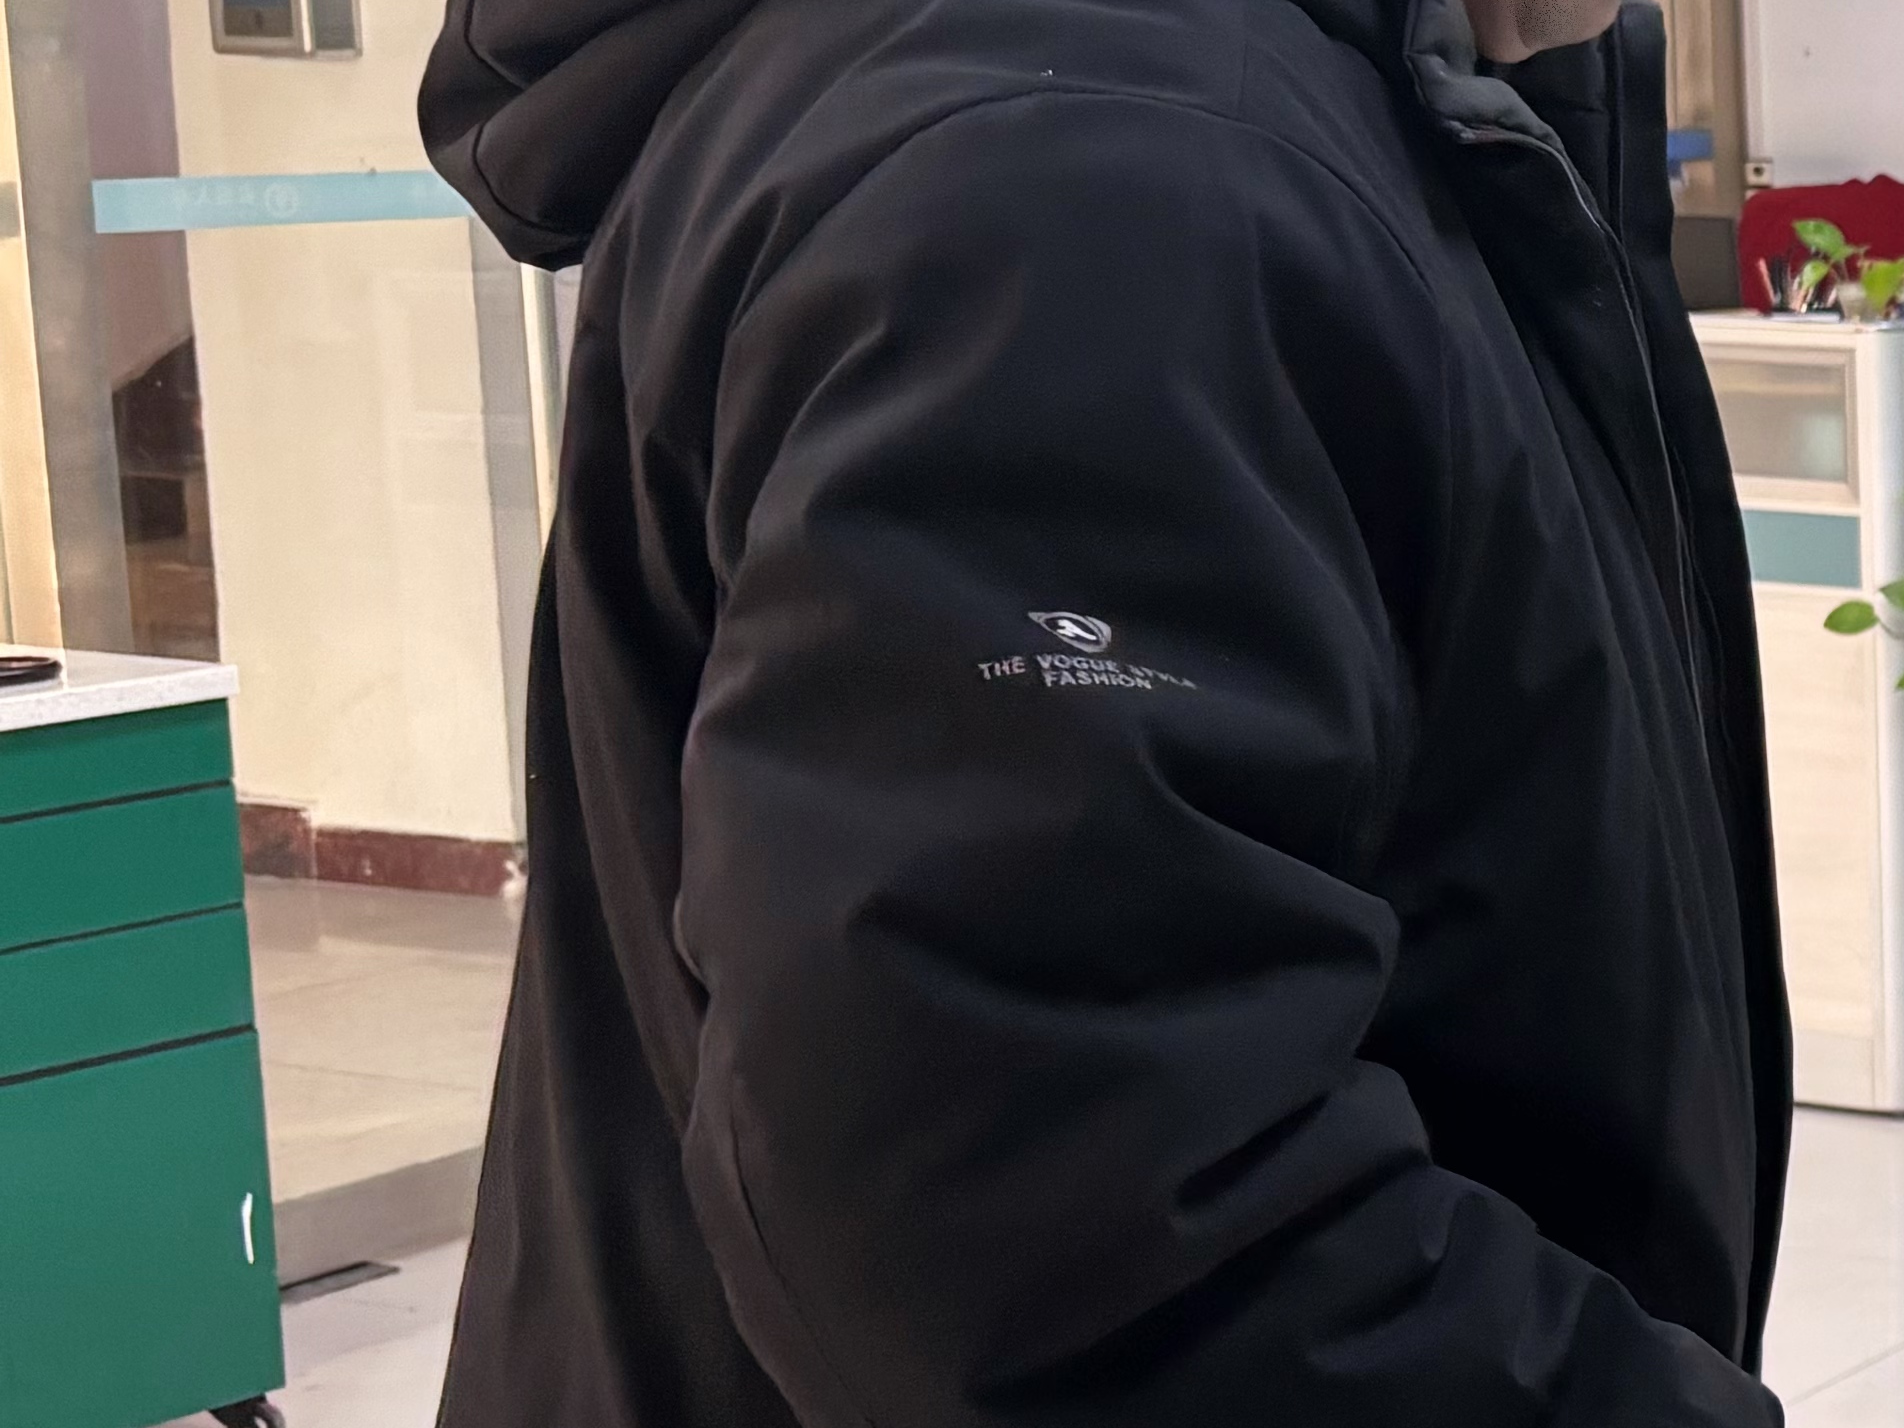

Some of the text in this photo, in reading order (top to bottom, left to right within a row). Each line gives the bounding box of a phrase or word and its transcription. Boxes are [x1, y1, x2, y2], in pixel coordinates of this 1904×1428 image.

[978, 656, 1026, 680] THE
[1036, 653, 1120, 673] VOGUE
[1042, 670, 1152, 689] FASHION
